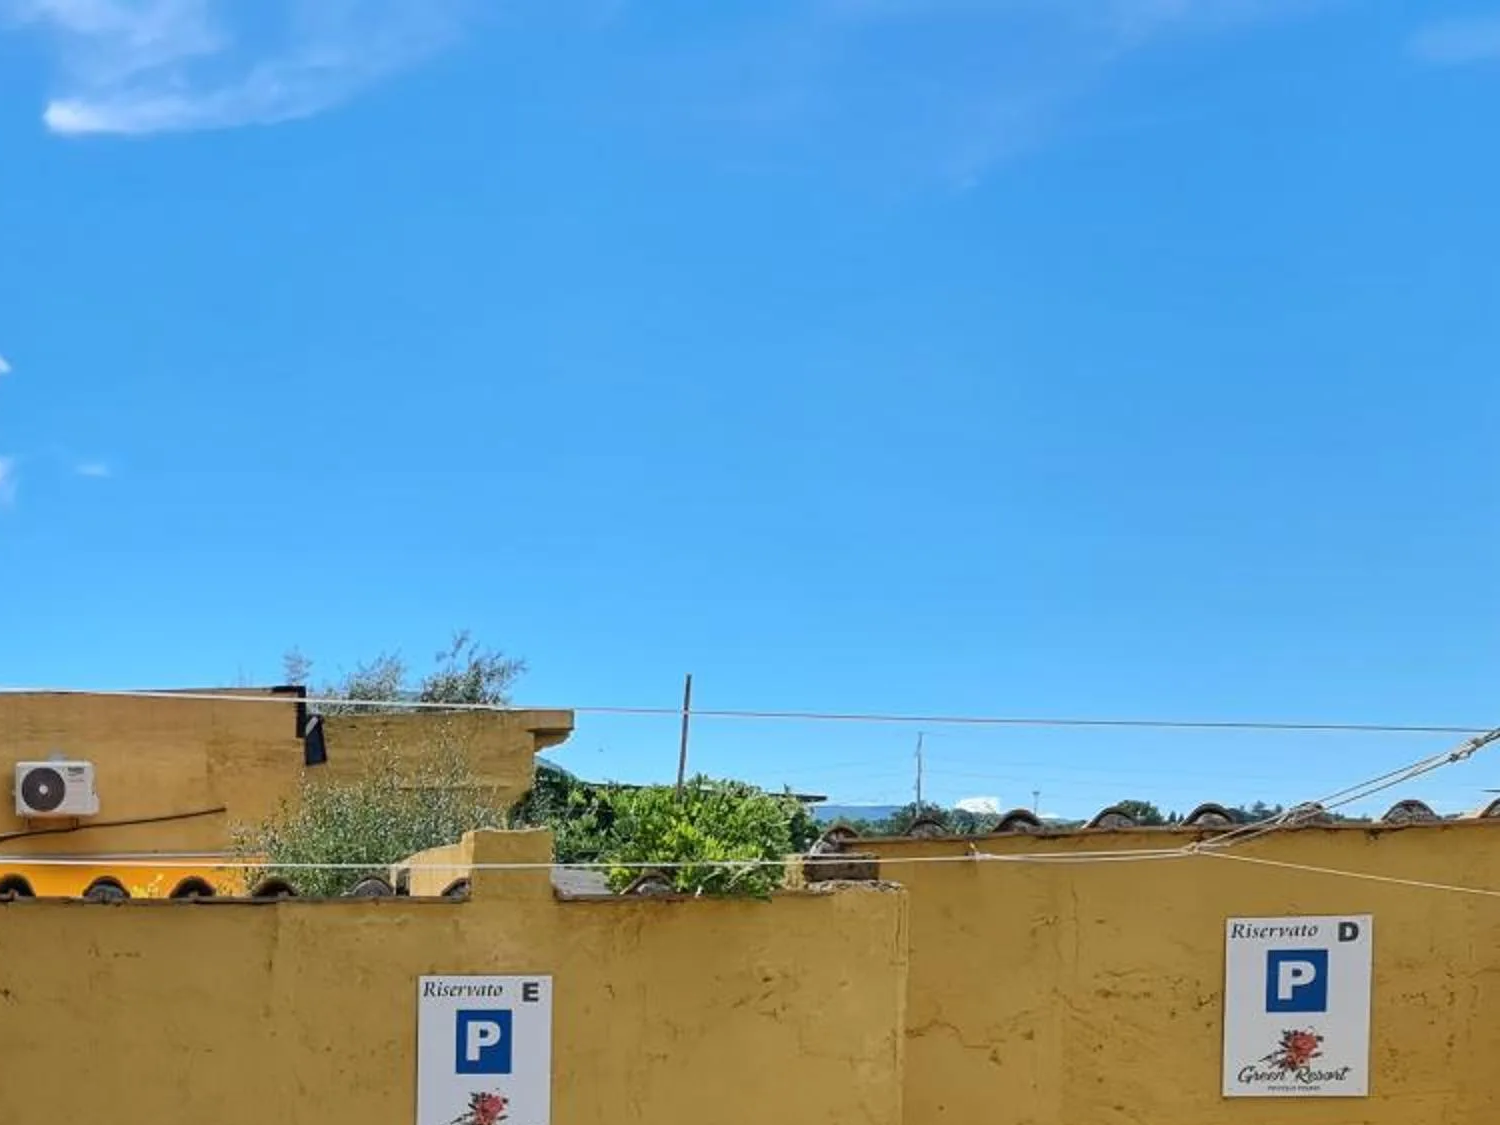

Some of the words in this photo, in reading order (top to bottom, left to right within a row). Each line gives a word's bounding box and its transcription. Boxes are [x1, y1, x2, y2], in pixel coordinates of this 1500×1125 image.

[1231, 923, 1319, 939] Riservato
[1338, 921, 1360, 942] D
[1277, 960, 1316, 1000] P
[423, 981, 503, 998] Riservato
[522, 981, 540, 1002] E
[466, 1021, 501, 1061] P
[1237, 1065, 1286, 1084] Green
